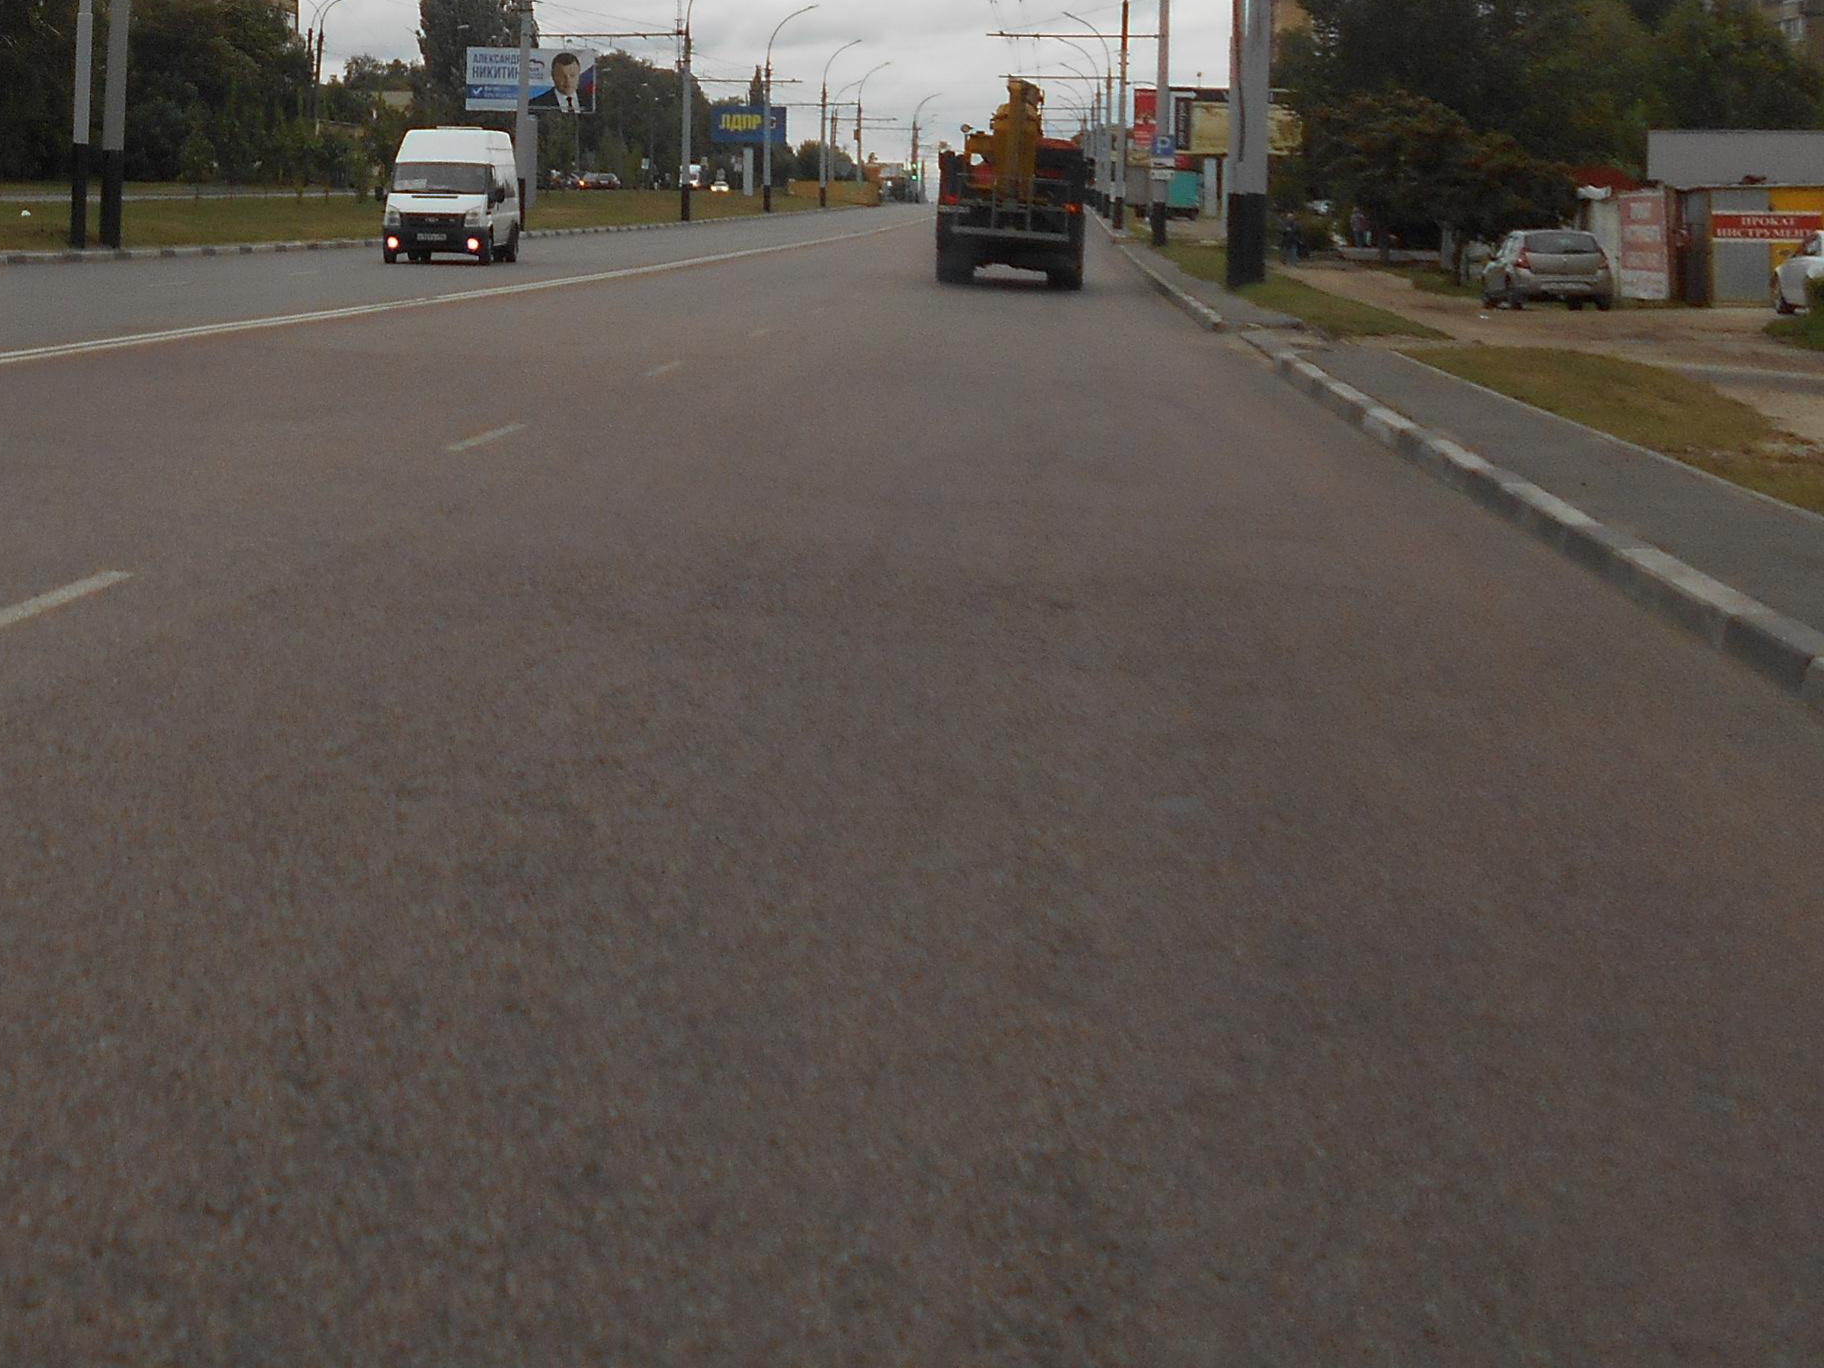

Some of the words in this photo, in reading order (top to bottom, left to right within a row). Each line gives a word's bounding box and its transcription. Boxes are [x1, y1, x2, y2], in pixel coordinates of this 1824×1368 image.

[719, 113, 762, 131] ЛДПР
[1741, 216, 1795, 226] ПРОКАТ
[1717, 228, 1814, 237] ИНСТРУМЕНТ
